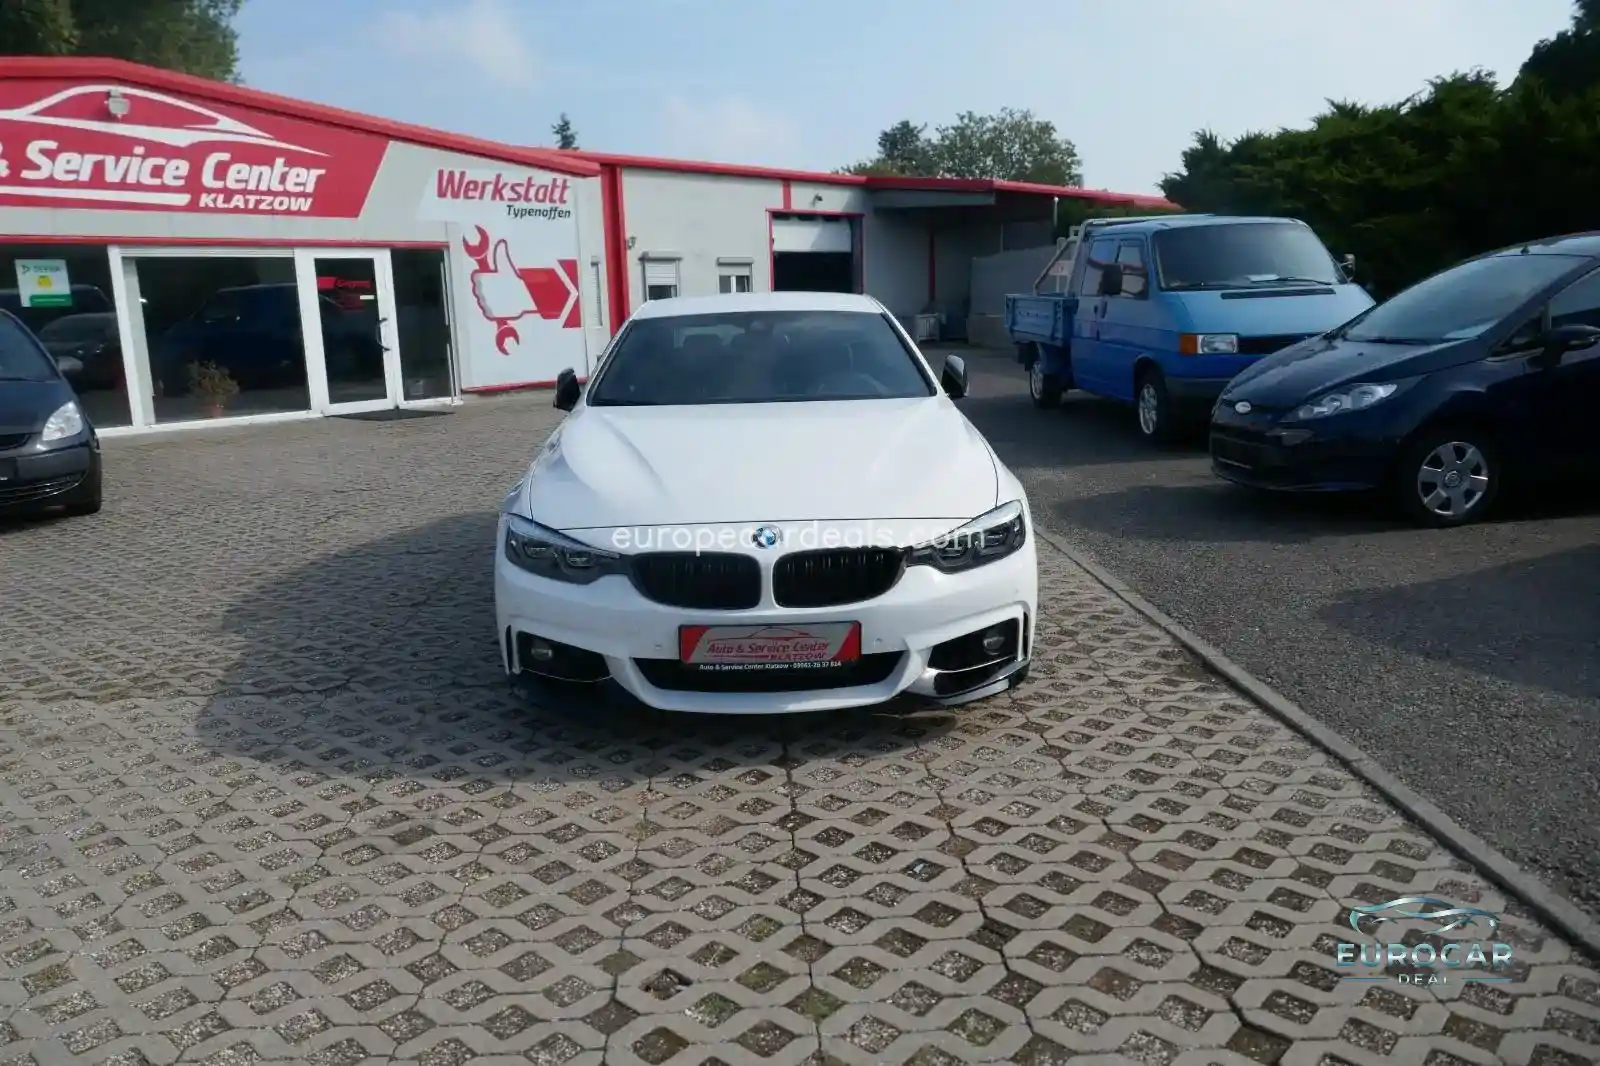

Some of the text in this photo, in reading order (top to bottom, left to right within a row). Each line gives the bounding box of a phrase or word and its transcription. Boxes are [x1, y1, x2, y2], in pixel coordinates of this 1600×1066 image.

[20, 139, 190, 187] Service
[201, 151, 326, 193] Center
[436, 168, 571, 204] Werkstatt
[198, 193, 314, 212] KLATZOW
[506, 204, 572, 220] Typenoffen
[706, 642, 733, 654] Auto
[735, 644, 745, 653] &
[747, 641, 791, 653] Service
